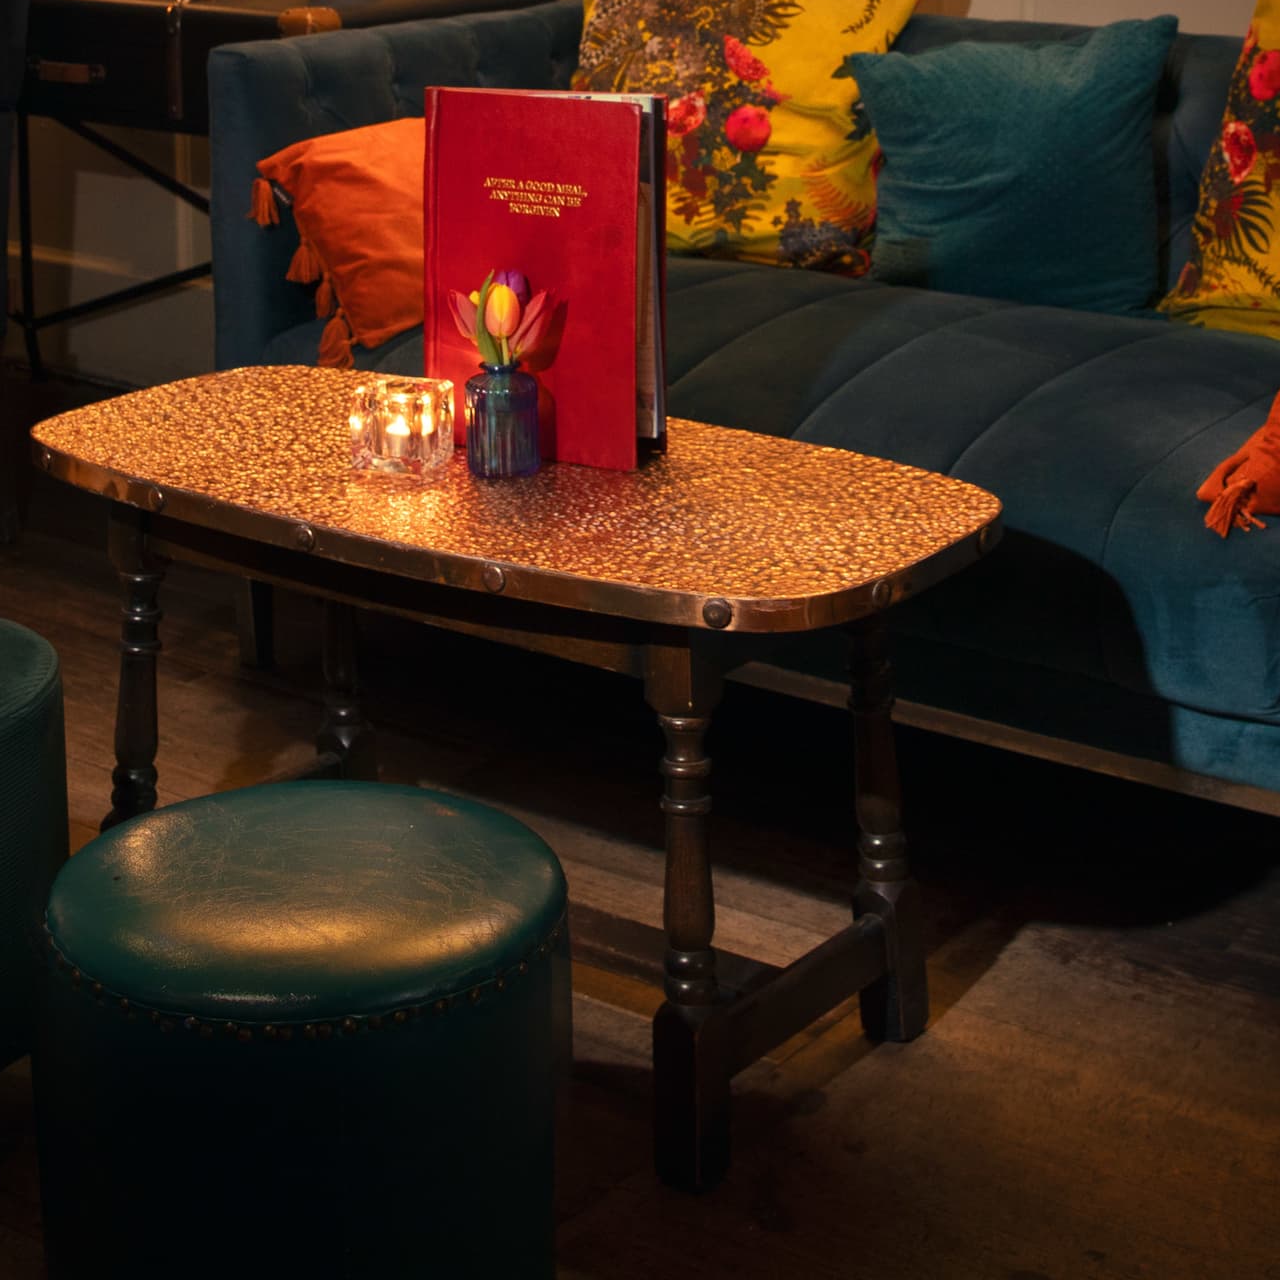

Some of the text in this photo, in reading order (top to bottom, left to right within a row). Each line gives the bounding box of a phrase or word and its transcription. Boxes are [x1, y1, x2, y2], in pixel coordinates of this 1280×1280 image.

[483, 177, 516, 189] AFTER
[517, 180, 524, 190] A
[525, 180, 555, 192] GOOD
[489, 190, 581, 207] ANYTHING CAN BE
[508, 202, 561, 217] FORGIVEN
